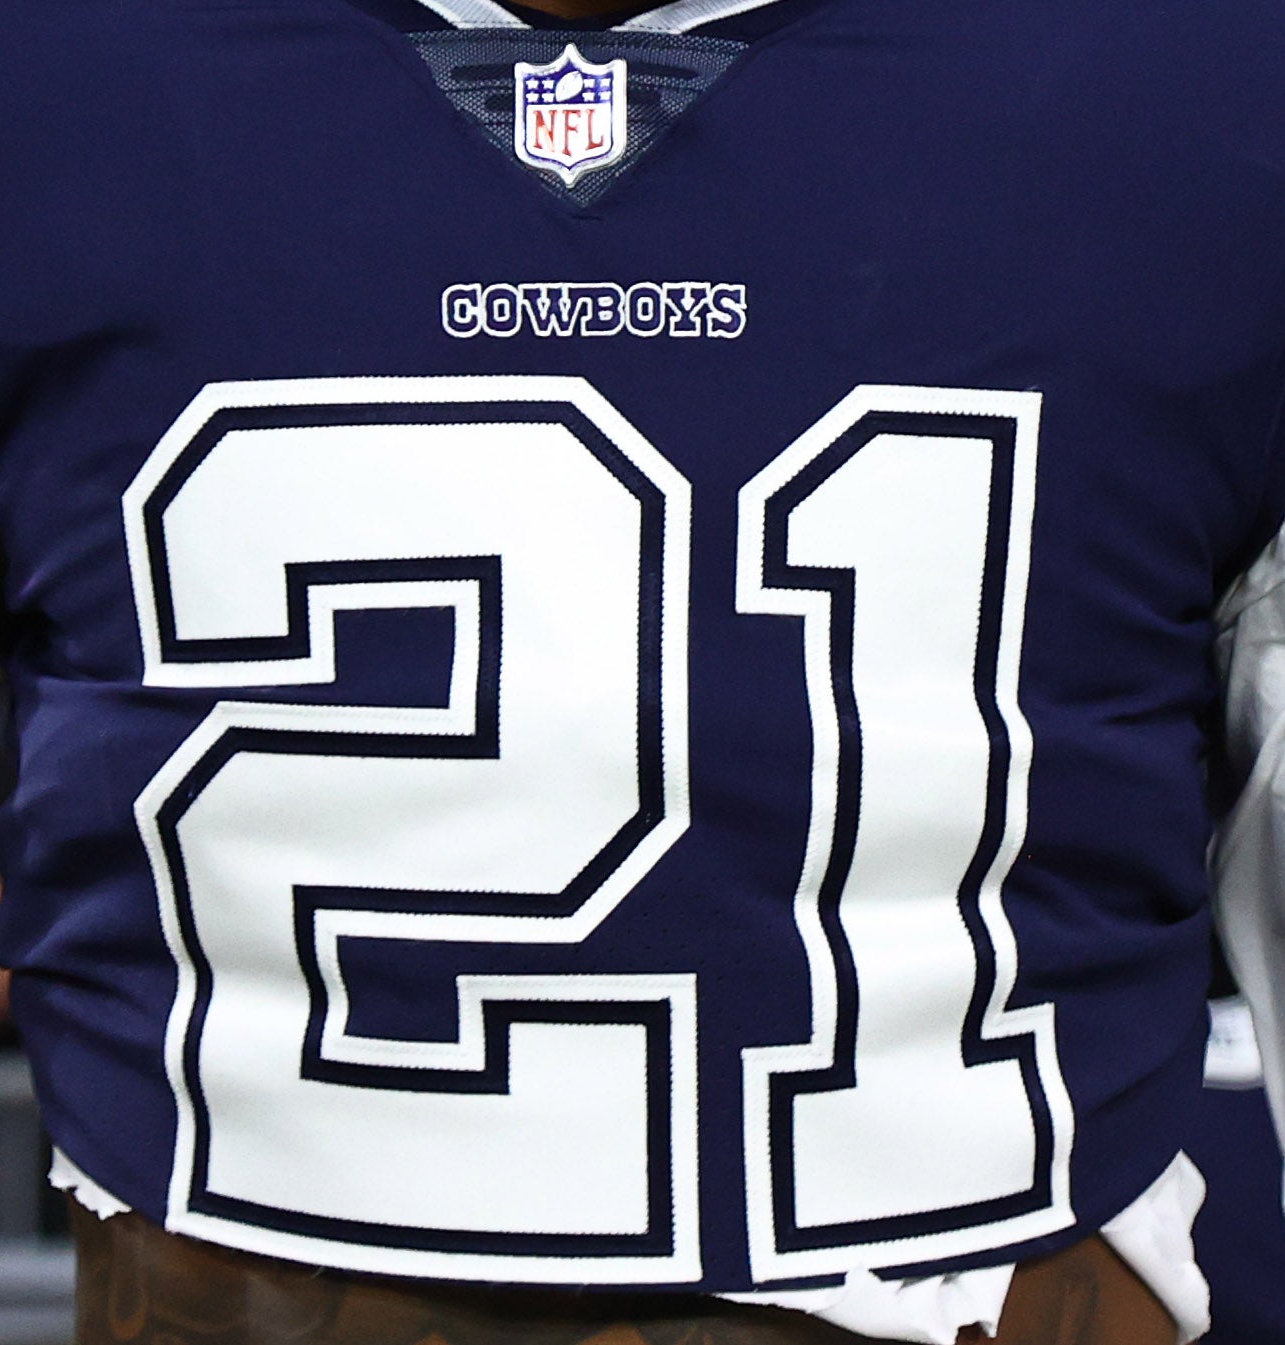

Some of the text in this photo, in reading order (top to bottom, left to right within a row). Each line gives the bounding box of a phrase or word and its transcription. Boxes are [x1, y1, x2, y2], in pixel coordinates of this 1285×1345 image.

[532, 108, 605, 157] NFL
[441, 282, 747, 338] COWBOYS
[121, 374, 1077, 1285] 21
